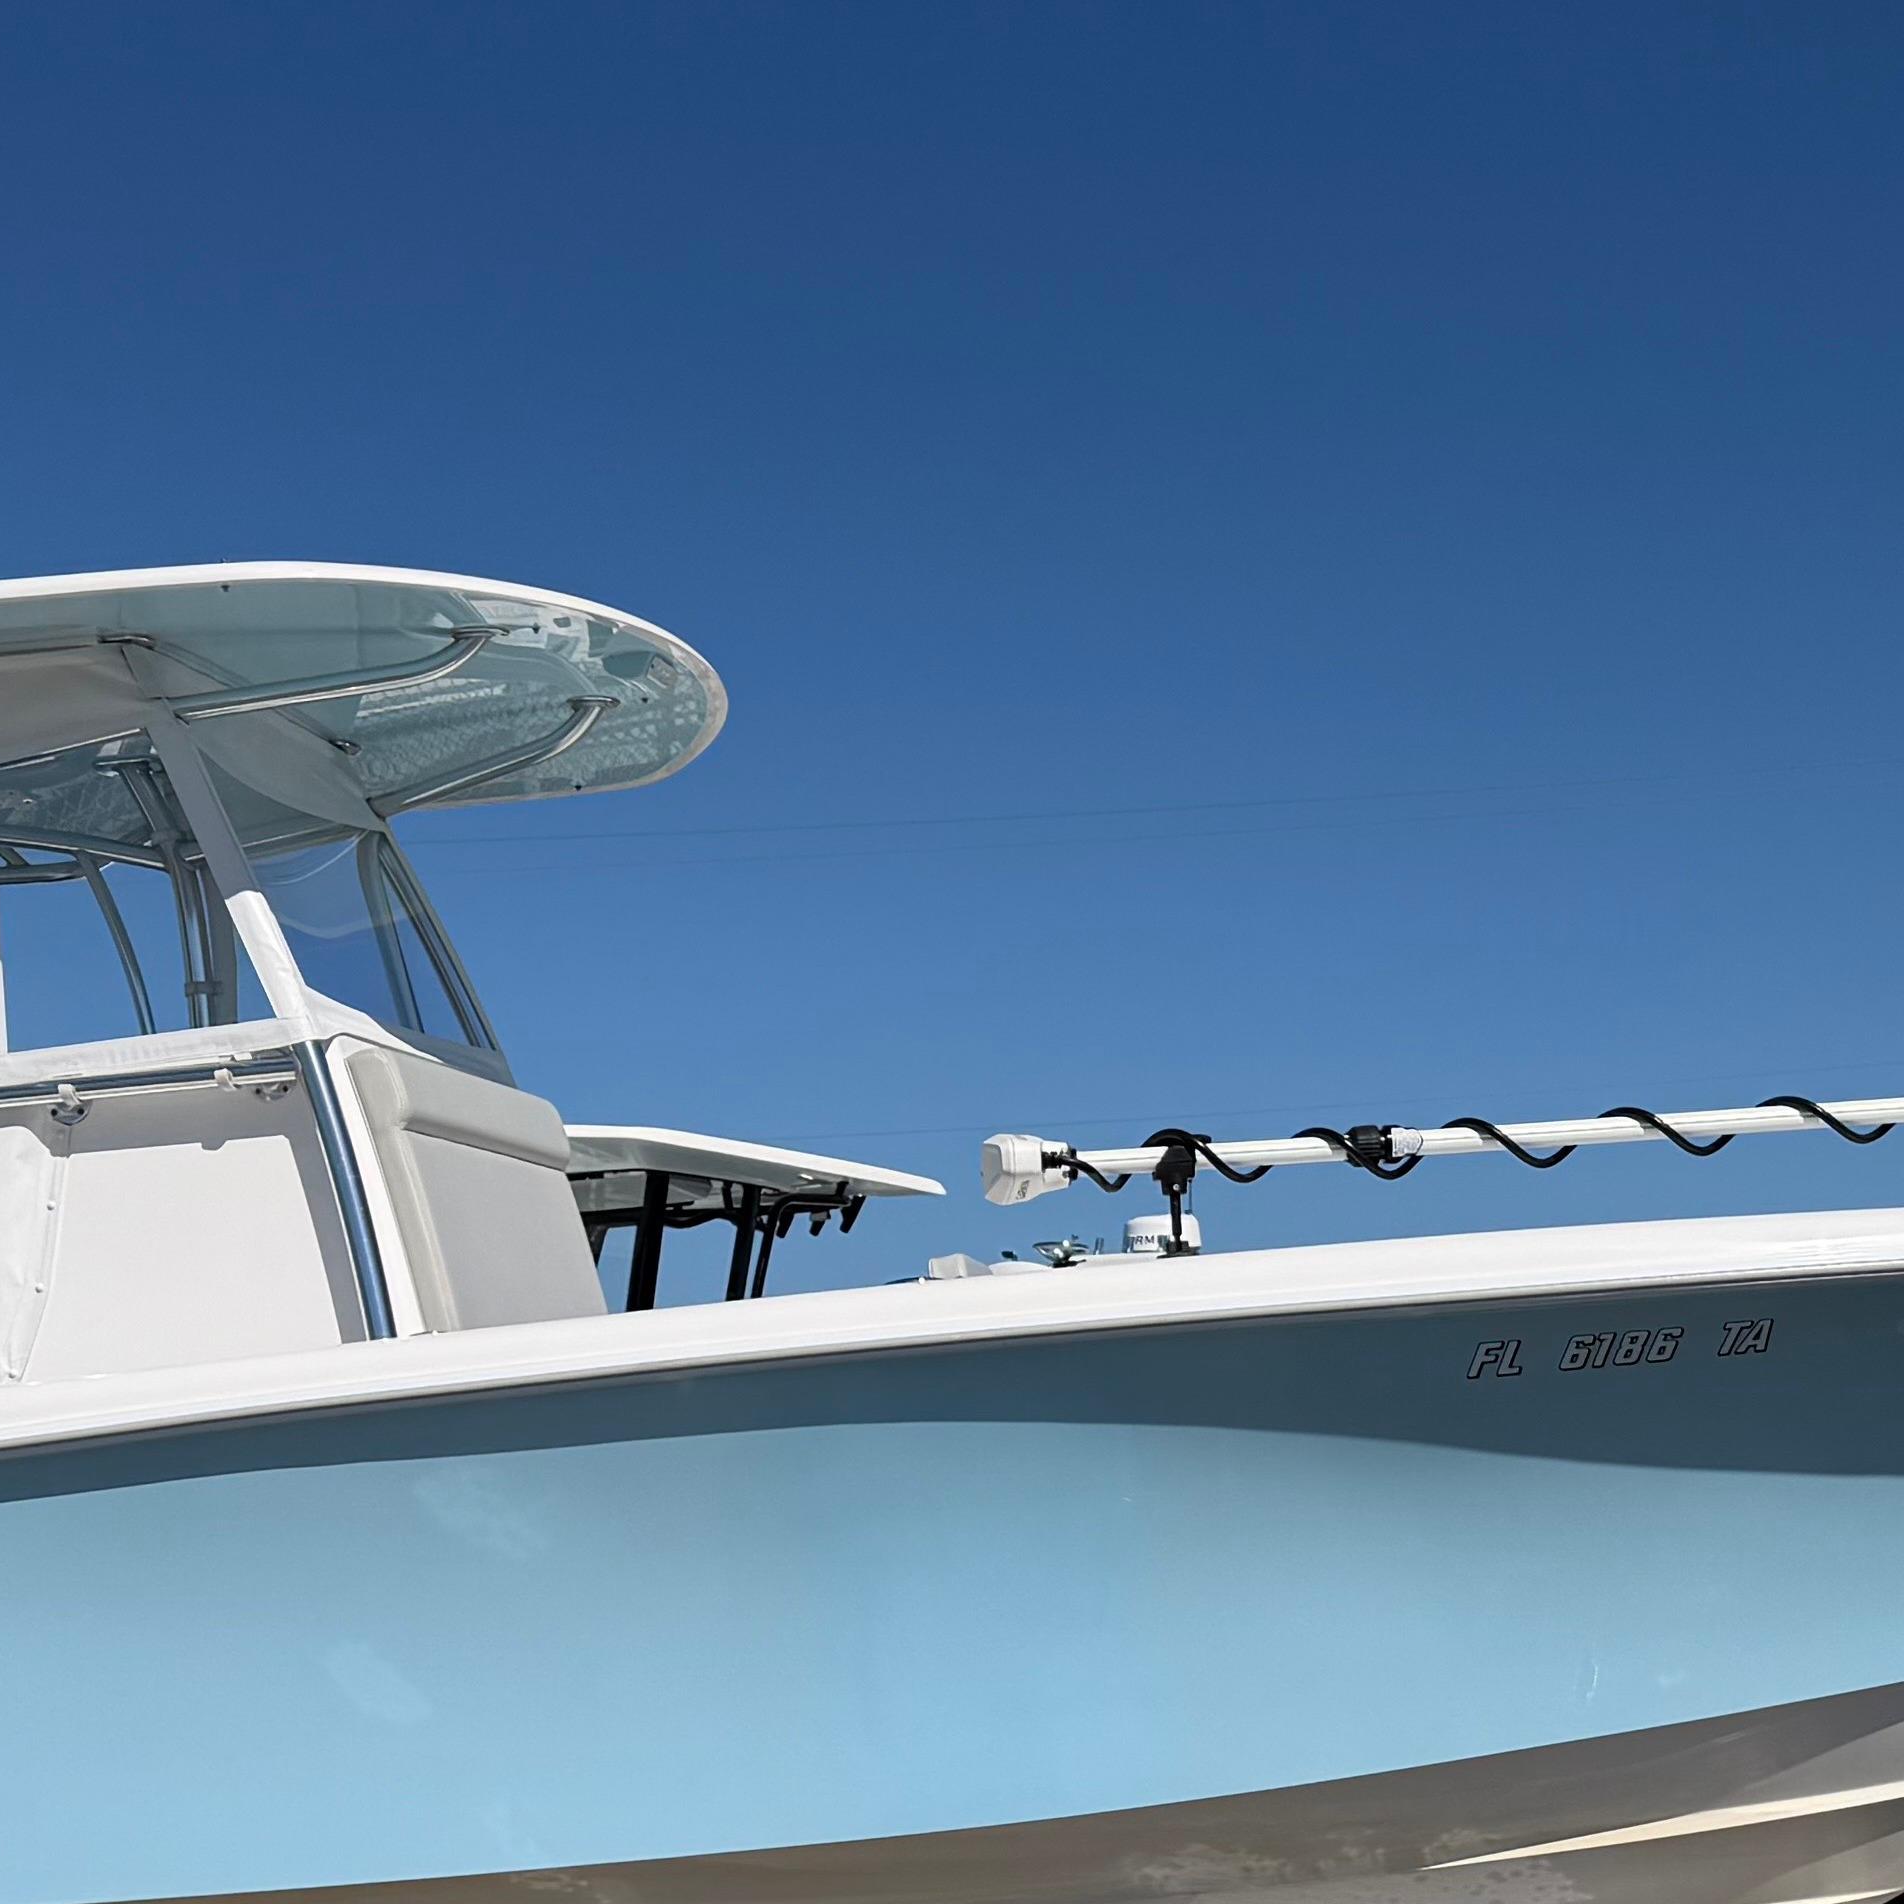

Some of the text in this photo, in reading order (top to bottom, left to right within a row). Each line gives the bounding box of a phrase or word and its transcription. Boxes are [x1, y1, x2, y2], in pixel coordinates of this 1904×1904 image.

[1466, 1318, 1775, 1379] FL 6186 TA
